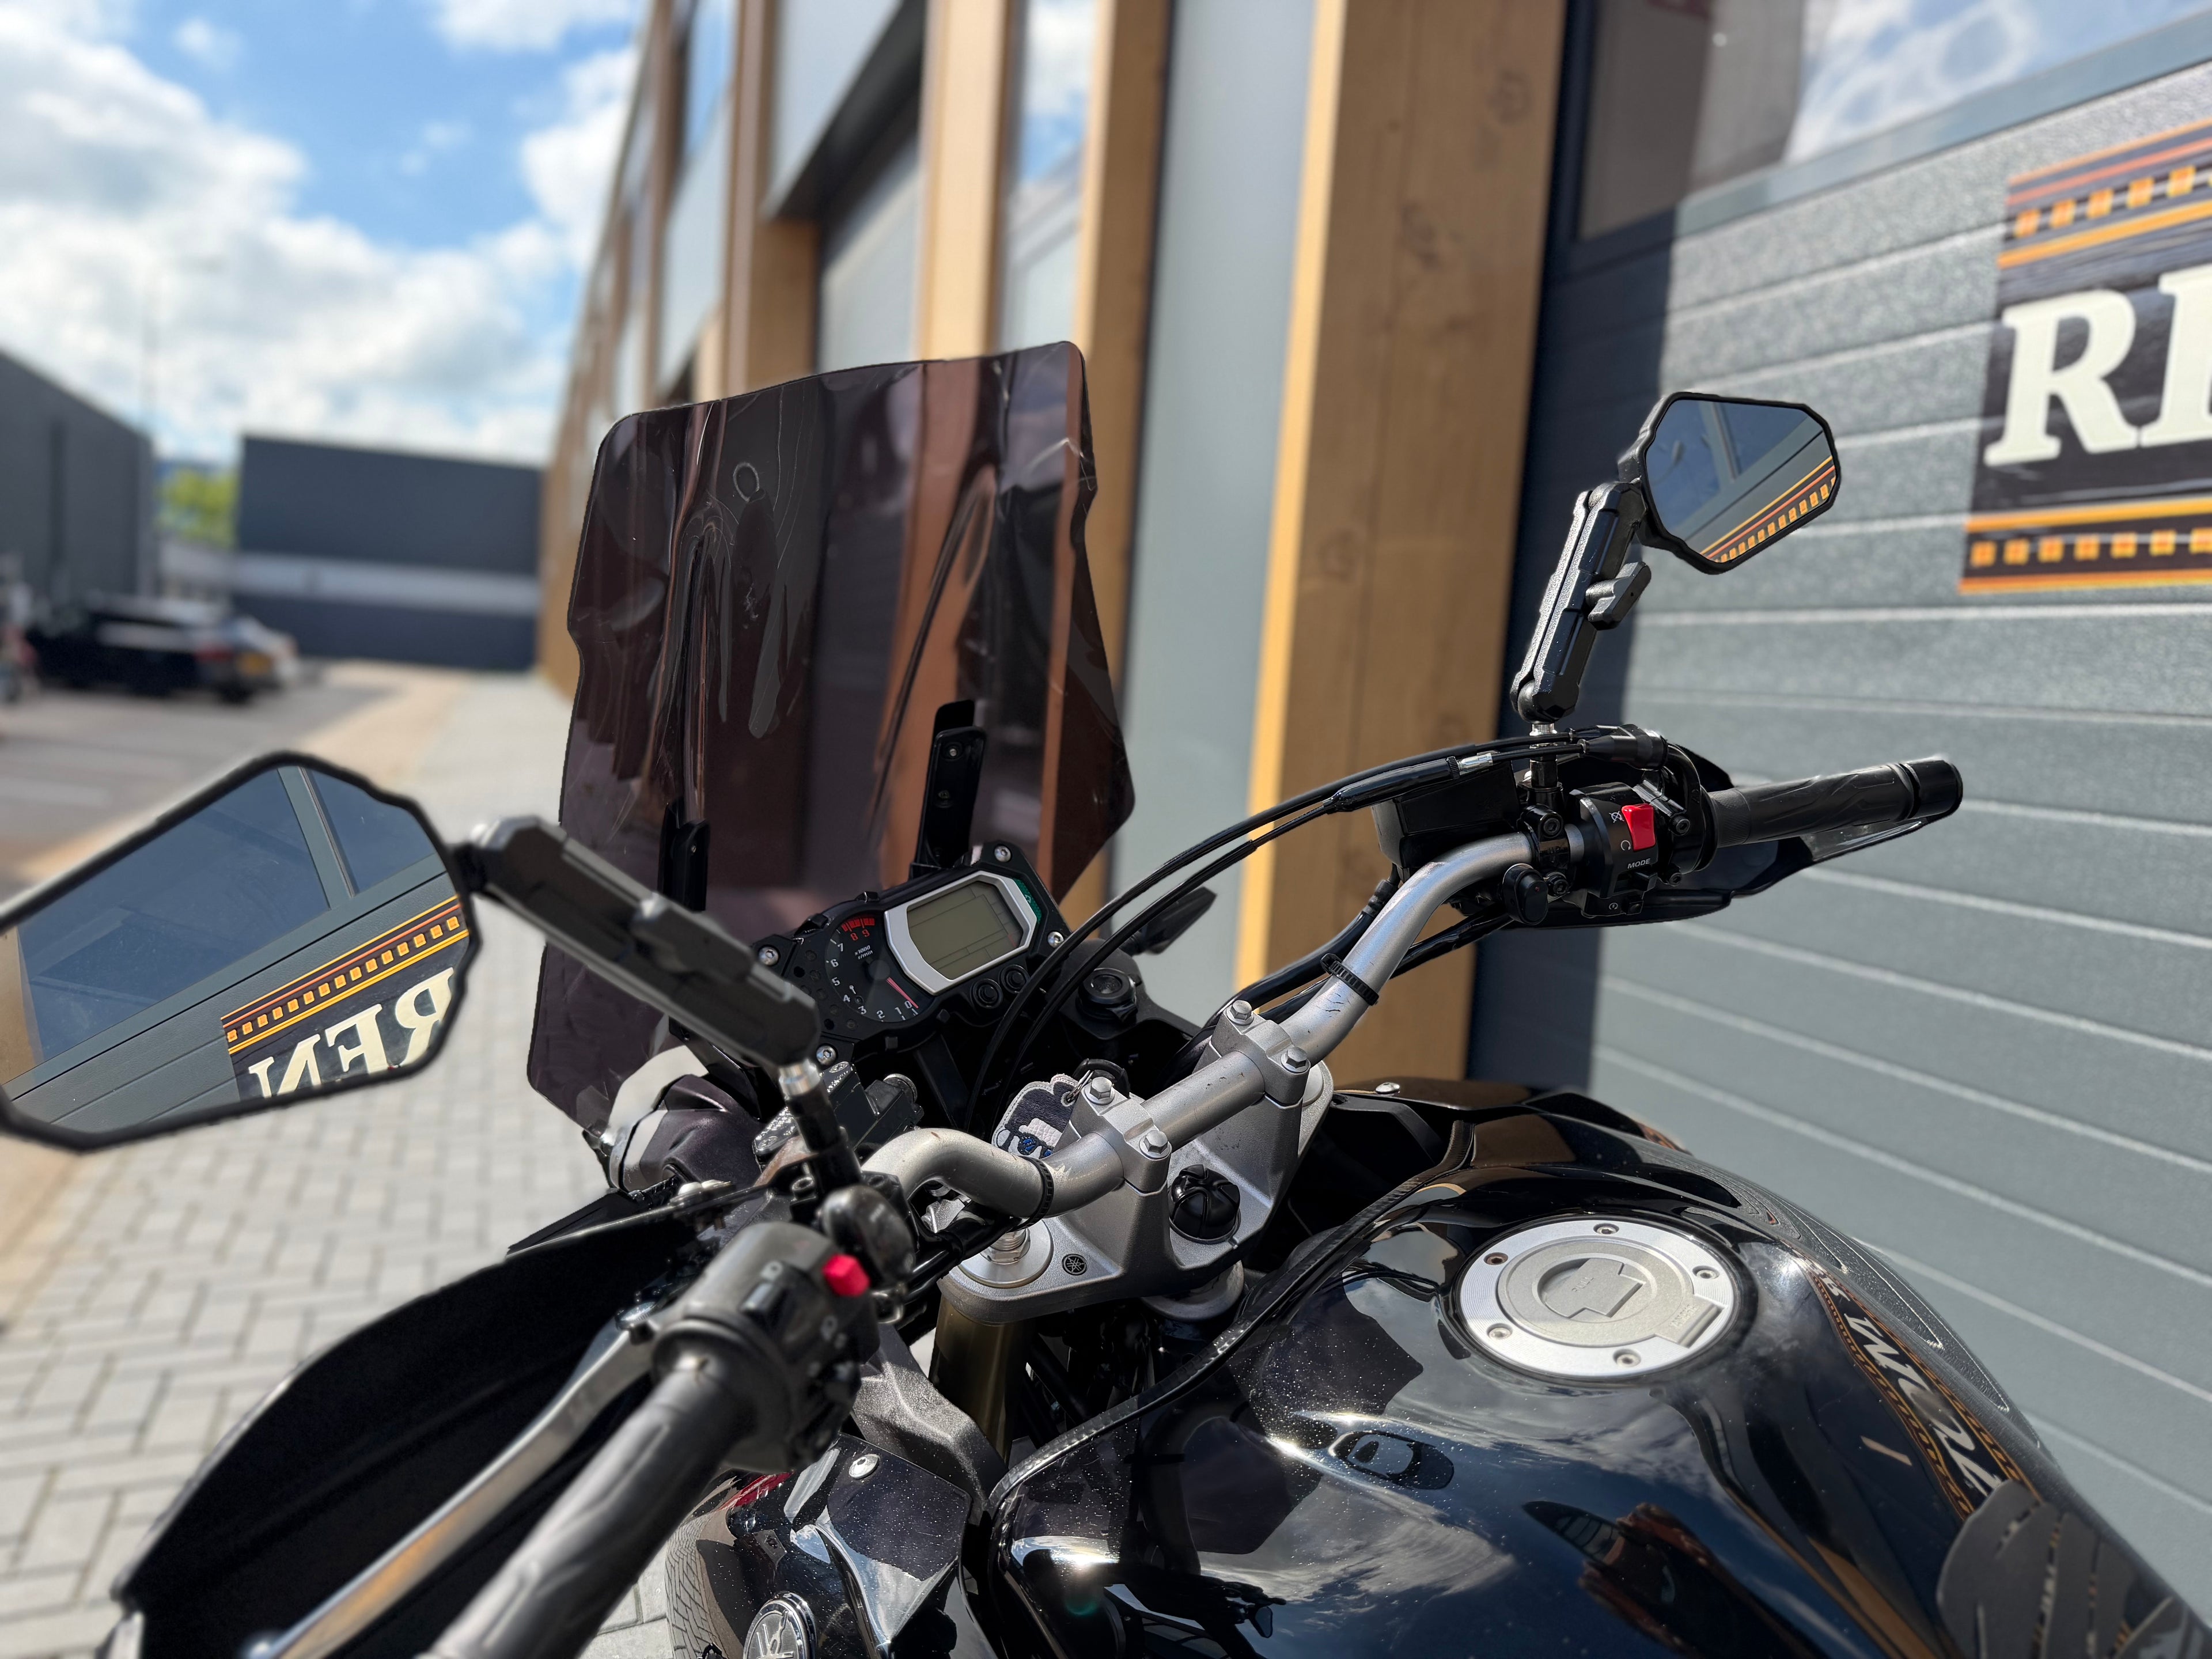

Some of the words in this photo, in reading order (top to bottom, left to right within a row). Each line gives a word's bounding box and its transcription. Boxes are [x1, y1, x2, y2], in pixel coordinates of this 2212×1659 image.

[1627, 858, 1651, 869] MODE
[850, 932, 859, 941] 8
[862, 929, 870, 937] 9
[838, 942, 844, 952] 7
[858, 949, 873, 960] r/min
[830, 959, 839, 968] 6
[831, 976, 840, 986] 5
[843, 994, 851, 1003] 4
[904, 1000, 912, 1009] 0
[858, 1005, 867, 1015] 3
[876, 1010, 885, 1019] 2
